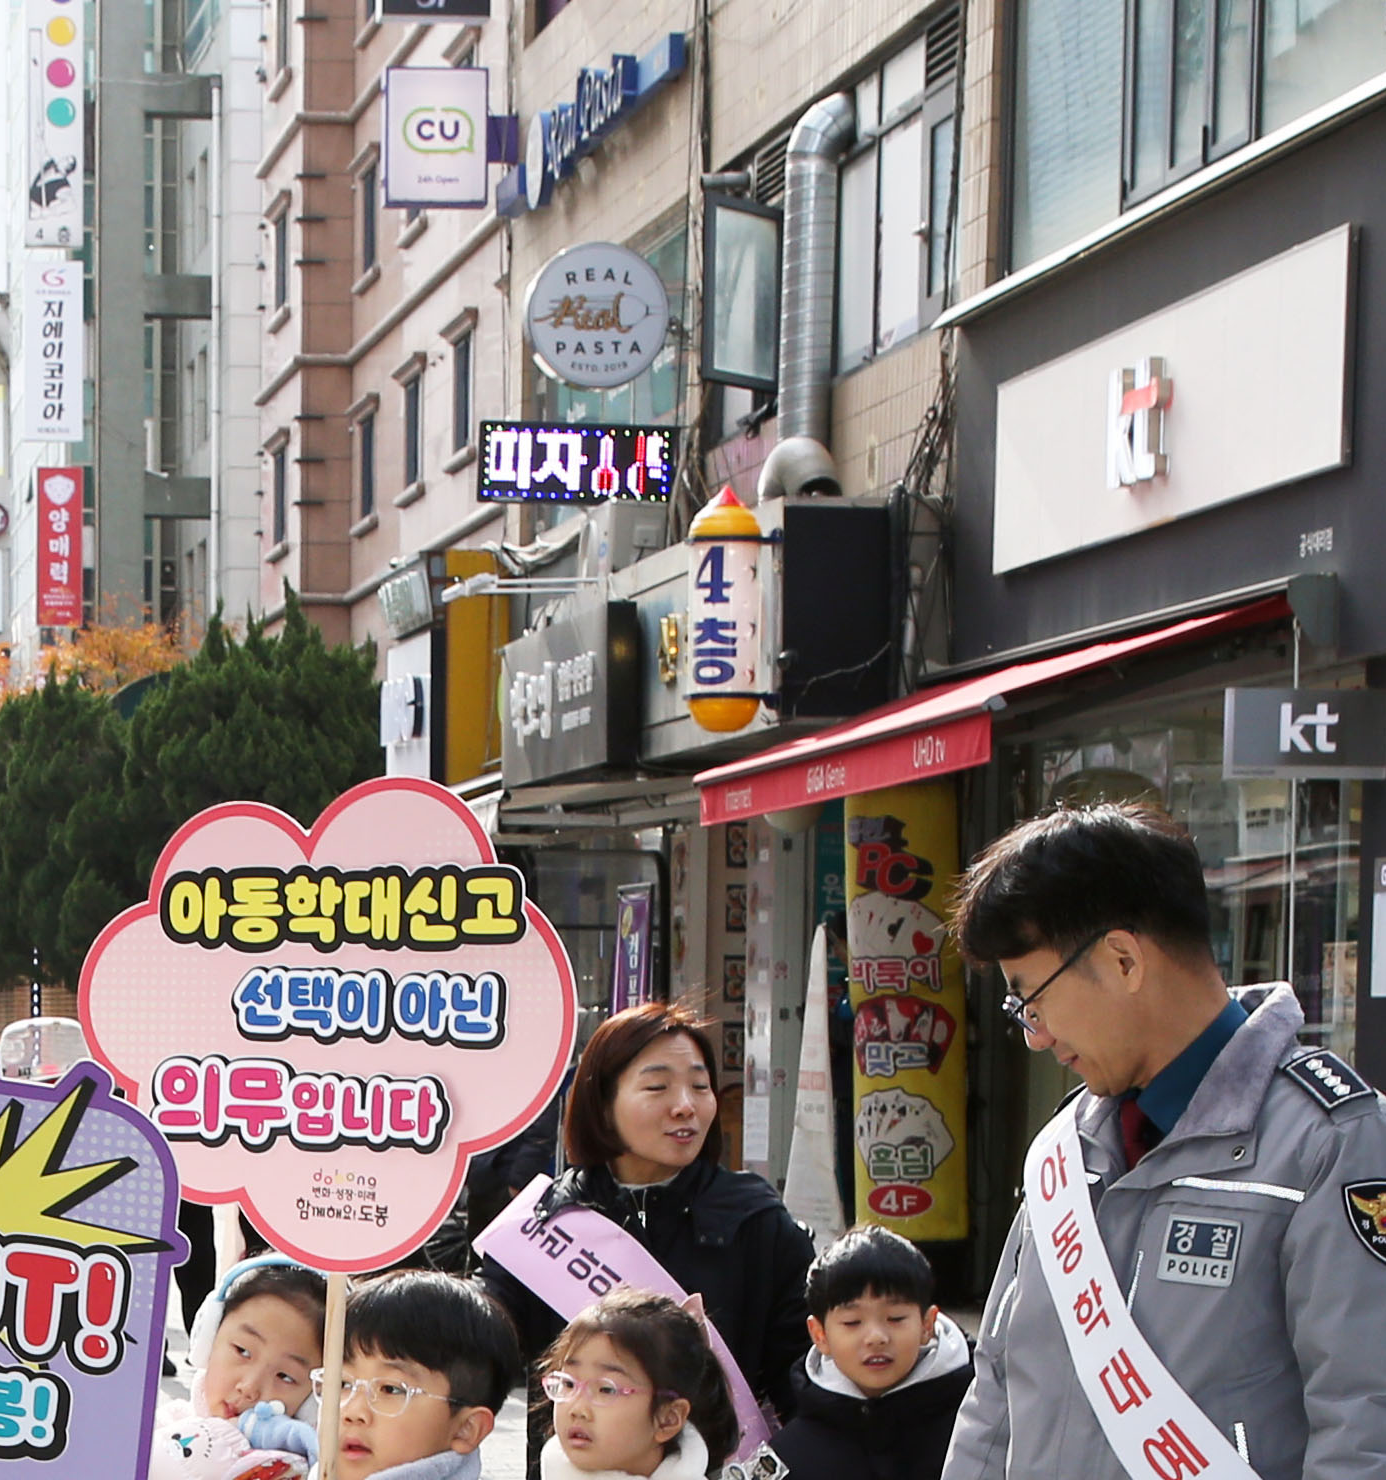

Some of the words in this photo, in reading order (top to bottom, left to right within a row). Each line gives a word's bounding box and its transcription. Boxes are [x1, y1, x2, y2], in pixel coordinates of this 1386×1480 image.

[416, 119, 460, 141] CU
[565, 267, 633, 286] REAL
[42, 300, 66, 421] 지에이코리아
[556, 341, 642, 355] PASTA
[1107, 356, 1174, 490] kt
[694, 545, 737, 686] 4층
[1279, 702, 1340, 753] kt
[913, 736, 934, 768] UHD
[936, 738, 946, 763] tv
[826, 761, 846, 790] Genie
[856, 842, 920, 896] PC
[168, 873, 521, 945] 아동학대신고
[852, 955, 942, 992] 바둑이
[239, 974, 381, 1031] 선택이
[398, 973, 495, 1036] 아닌
[866, 1044, 929, 1075] 맞고
[157, 1062, 437, 1138] 의무입니다
[869, 1144, 931, 1179] 홀덤
[296, 1197, 357, 1221] 함께해요!
[358, 1204, 389, 1228] 도봉
[879, 1187, 918, 1214] 4F
[1173, 1222, 1234, 1259] 경찰
[1165, 1258, 1229, 1281] POLICE
